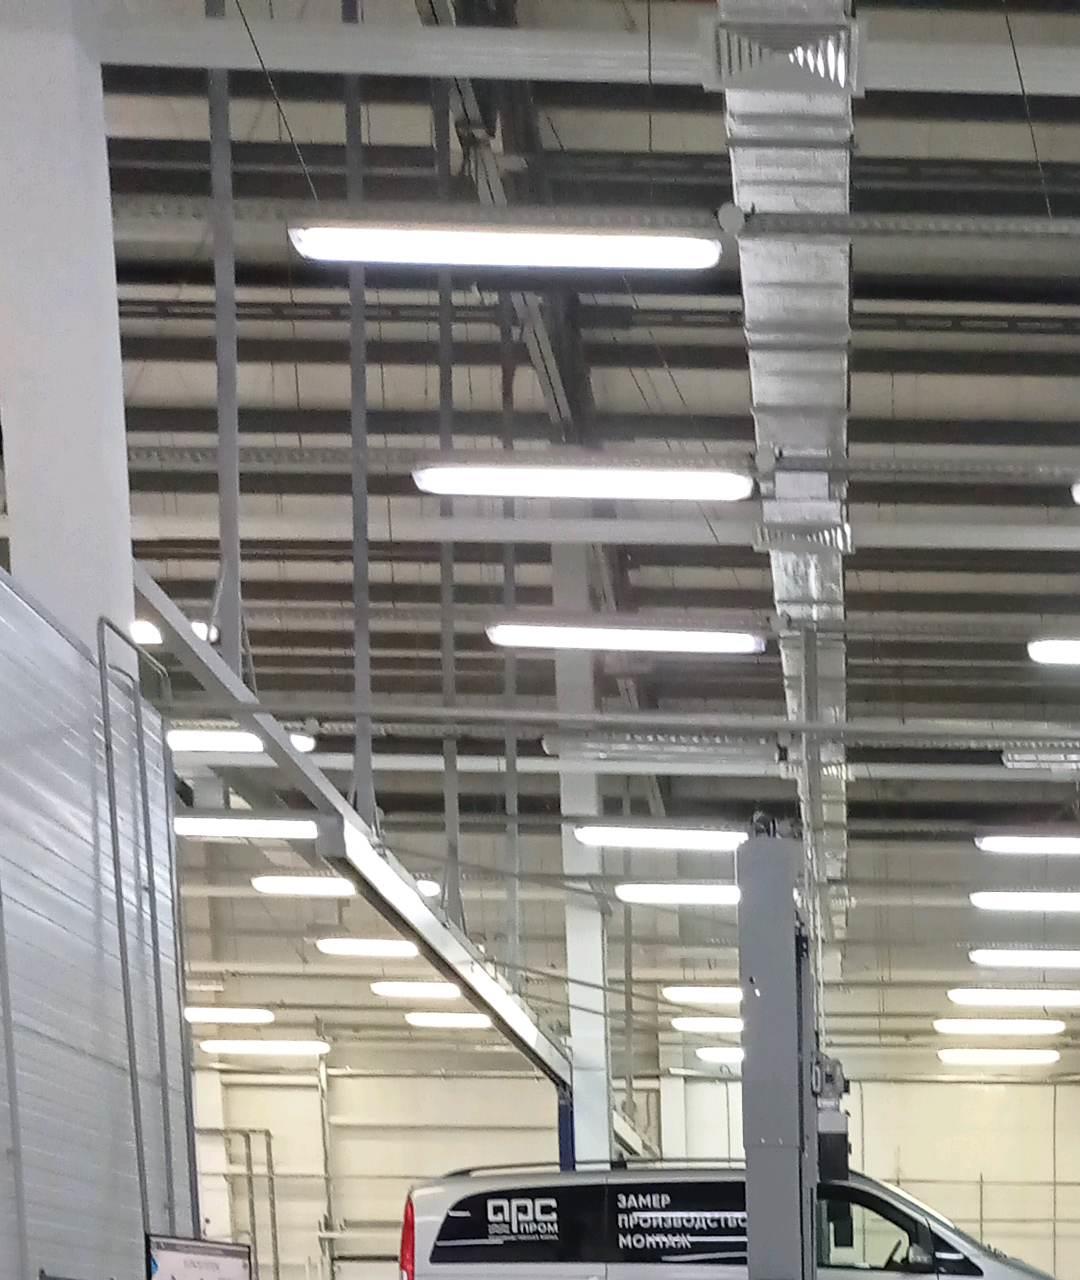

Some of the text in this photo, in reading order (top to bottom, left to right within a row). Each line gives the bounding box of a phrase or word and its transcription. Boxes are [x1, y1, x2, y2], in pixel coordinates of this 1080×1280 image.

[617, 1193, 671, 1209] ЗАМЕР
[520, 1222, 559, 1234] ПРОМ
[618, 1232, 692, 1250] МОНТАЖ
